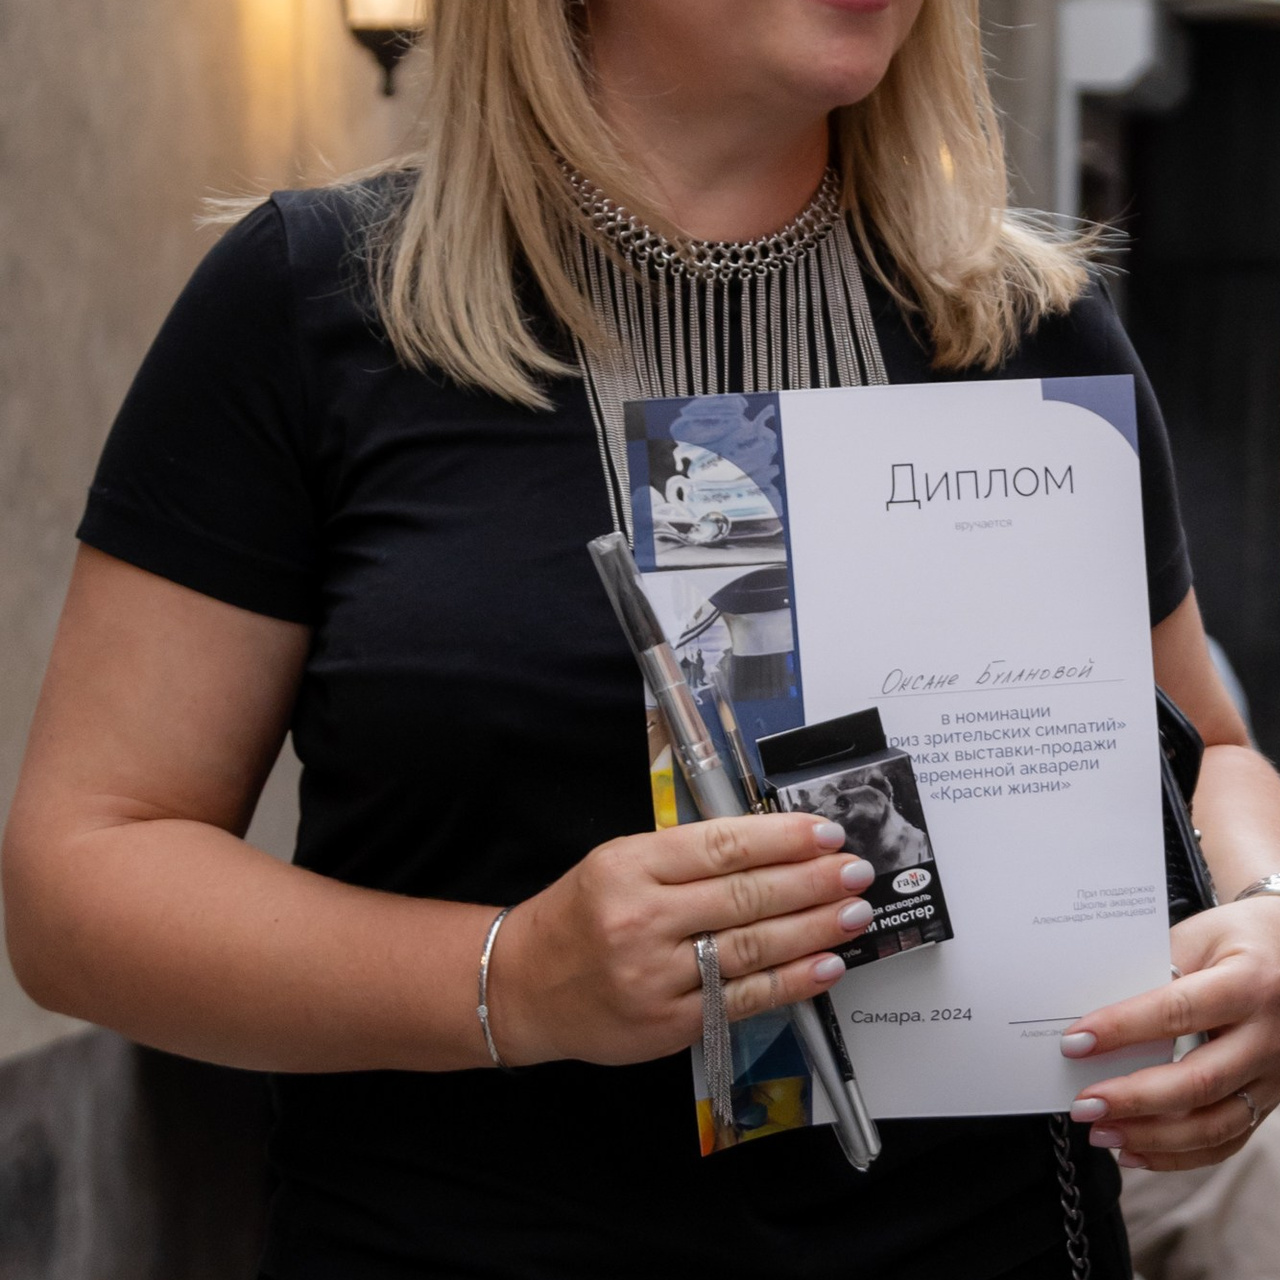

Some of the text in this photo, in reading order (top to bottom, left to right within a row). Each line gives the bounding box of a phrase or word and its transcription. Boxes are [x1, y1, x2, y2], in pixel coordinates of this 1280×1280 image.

[886, 463, 1074, 511] Диплом
[954, 519, 1013, 531] вручается
[941, 706, 1052, 725] в номинации
[889, 717, 1127, 748] риз зрительских симпатий»
[910, 738, 1117, 765] мках выставки-продажи
[1020, 758, 1100, 779] акварели
[930, 780, 1071, 803] «Краски жизни»
[885, 893, 931, 912] акварель
[1077, 889, 1097, 900] При
[880, 905, 934, 929] мастер
[851, 1008, 972, 1025] Самара, 2024
